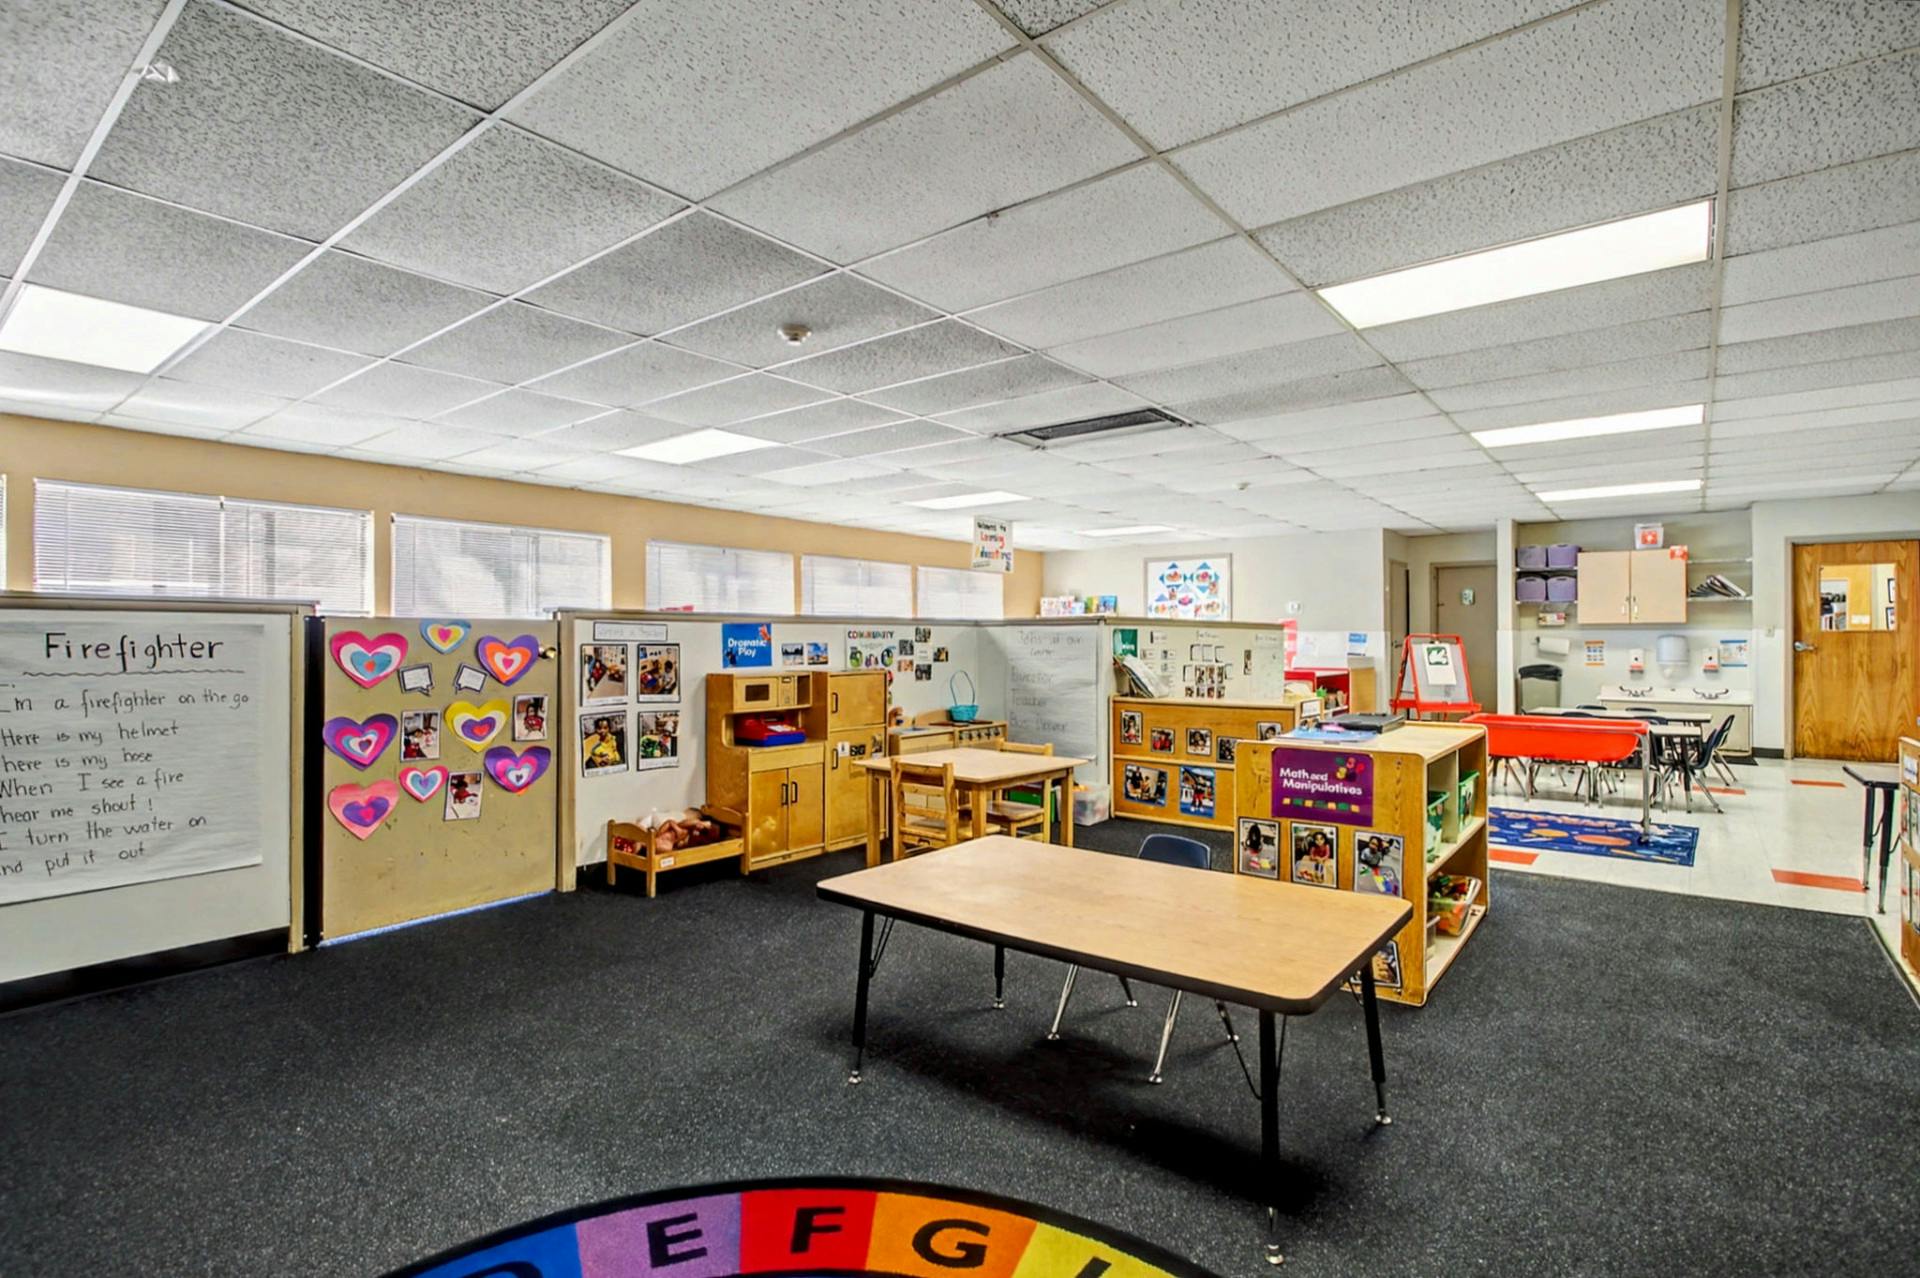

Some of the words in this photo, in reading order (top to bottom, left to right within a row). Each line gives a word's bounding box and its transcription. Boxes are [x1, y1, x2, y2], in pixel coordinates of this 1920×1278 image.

[45, 632, 224, 672] Firefighter
[738, 647, 757, 658] Play
[54, 697, 69, 710] a
[81, 689, 166, 718] firefighter
[178, 693, 196, 705] on
[203, 688, 227, 704] the
[229, 693, 249, 710] go
[1, 728, 41, 747] Here
[56, 734, 70, 743] is
[79, 731, 103, 747] my
[118, 721, 179, 741] helmet
[2, 755, 42, 774] here
[55, 757, 70, 769] is
[82, 756, 108, 770] my
[123, 748, 153, 763] hose
[1280, 767, 1309, 780] Math
[77, 772, 91, 792] I
[102, 777, 125, 790] see
[136, 776, 147, 787] a
[153, 767, 185, 792] fire
[1283, 779, 1362, 795] Manipulatives
[0, 805, 40, 824] hear
[51, 807, 74, 818] me
[91, 794, 137, 814] shout
[25, 828, 70, 847] turn
[86, 820, 113, 841] the
[123, 817, 175, 837] water
[188, 815, 207, 828] on
[0, 860, 23, 877] nd
[45, 851, 70, 877] put
[83, 851, 96, 864] it
[118, 842, 146, 860] out
[646, 1212, 708, 1269] E
[790, 1206, 846, 1255] F
[912, 1218, 991, 1268] G
